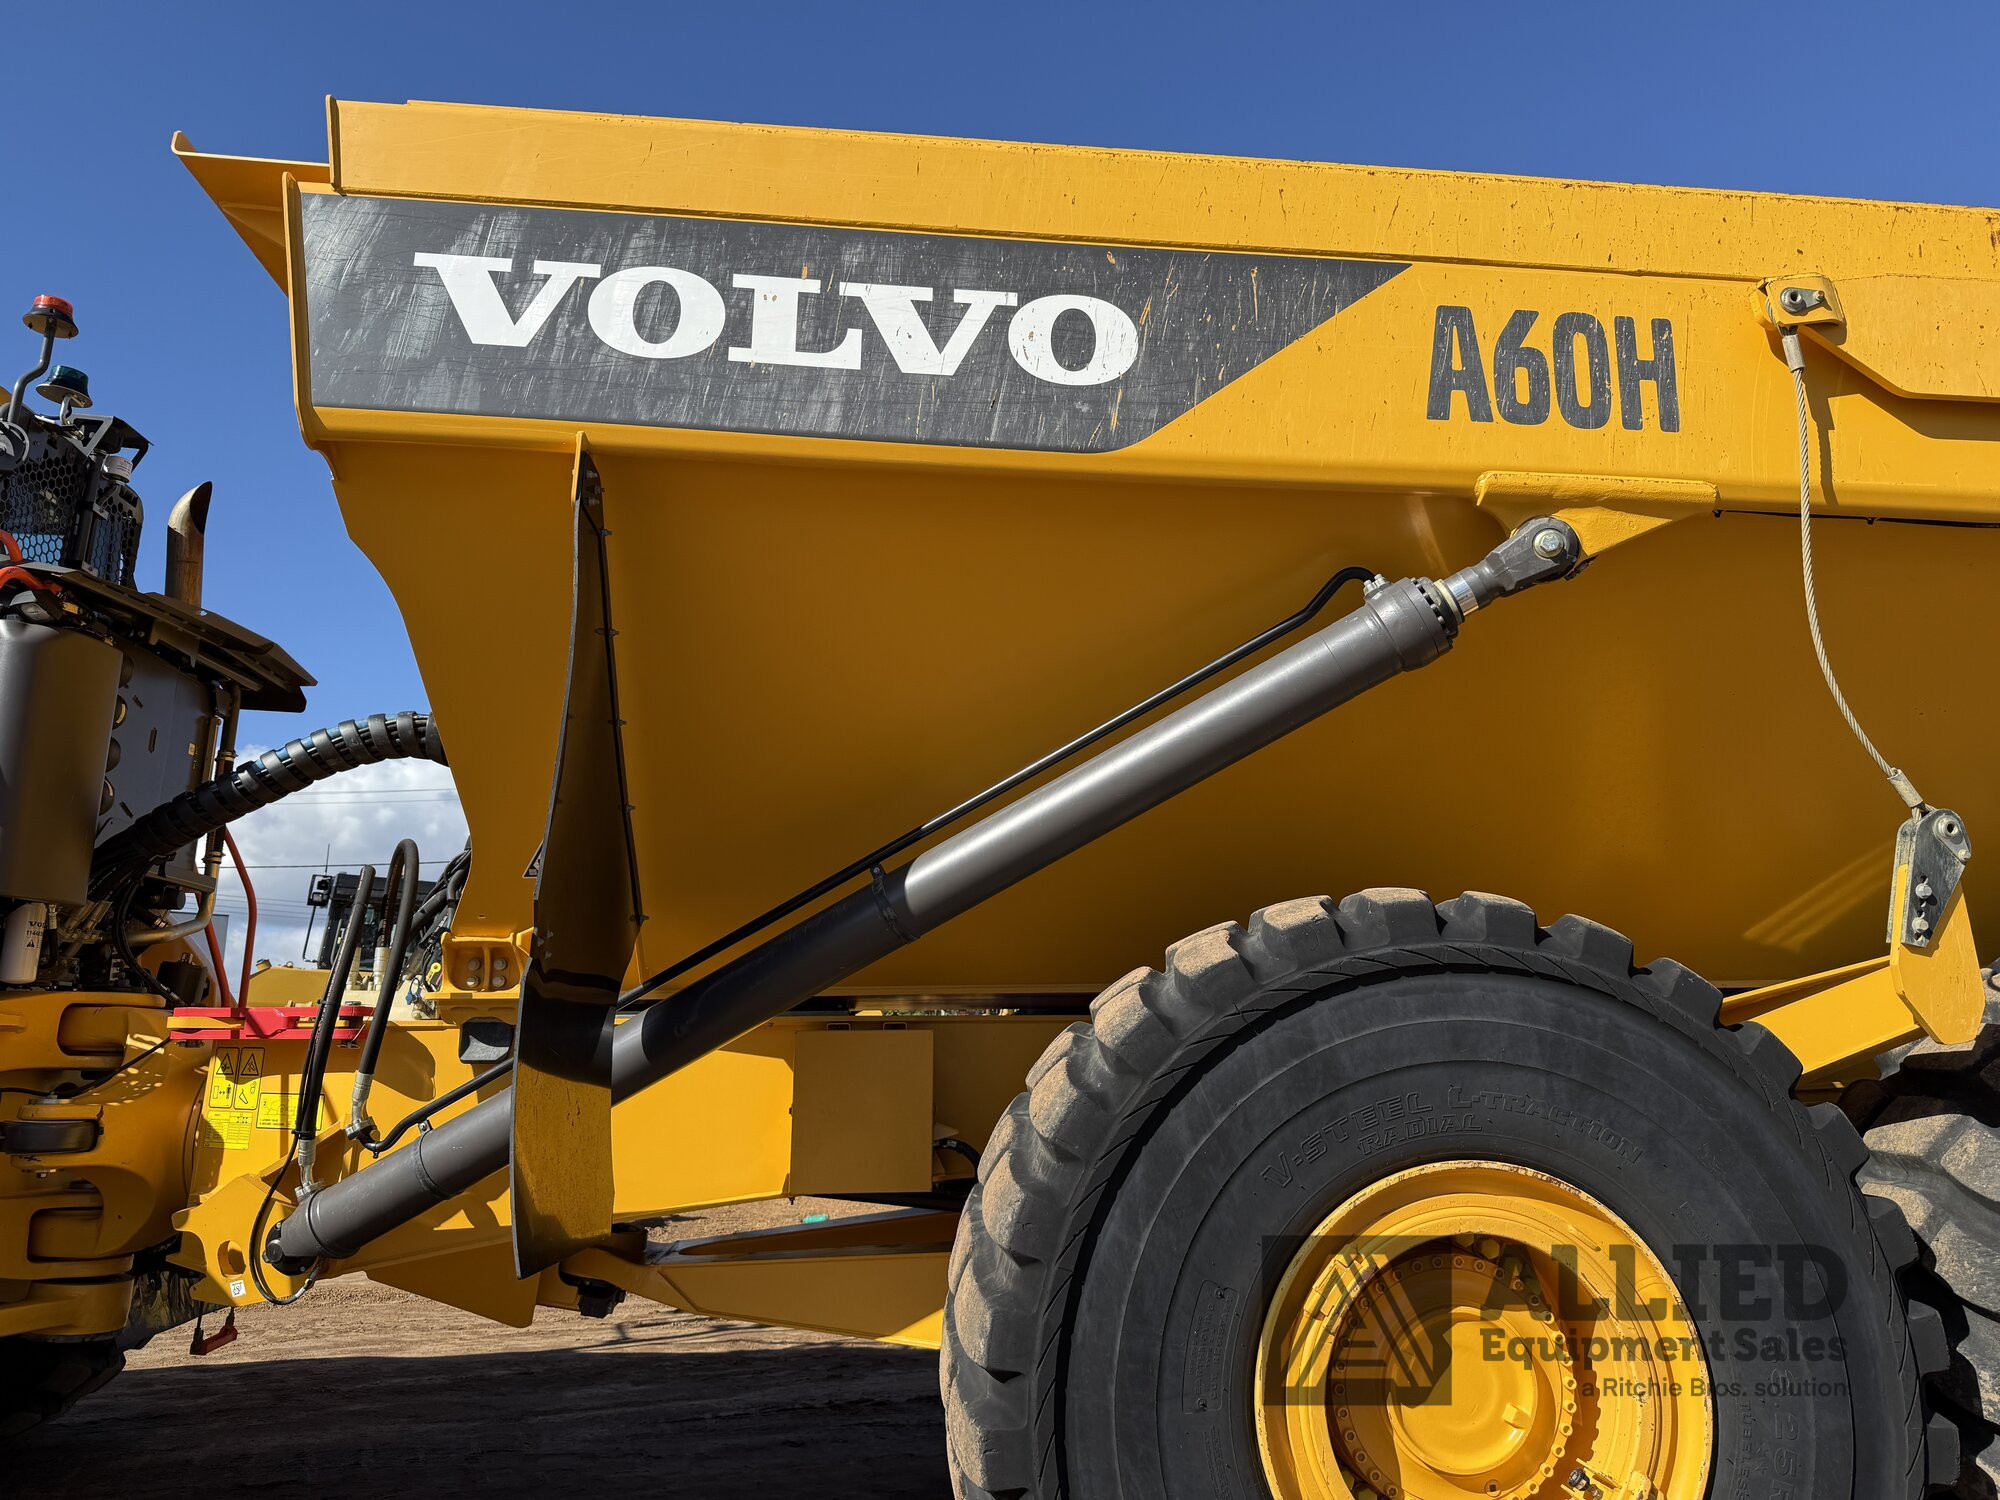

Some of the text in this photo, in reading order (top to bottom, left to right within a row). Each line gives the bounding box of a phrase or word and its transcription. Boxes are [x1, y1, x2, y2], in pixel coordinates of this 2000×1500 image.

[414, 252, 1140, 386] VOLVO
[1426, 304, 1681, 432] A60H
[1358, 1113, 1482, 1155] RADIAL
